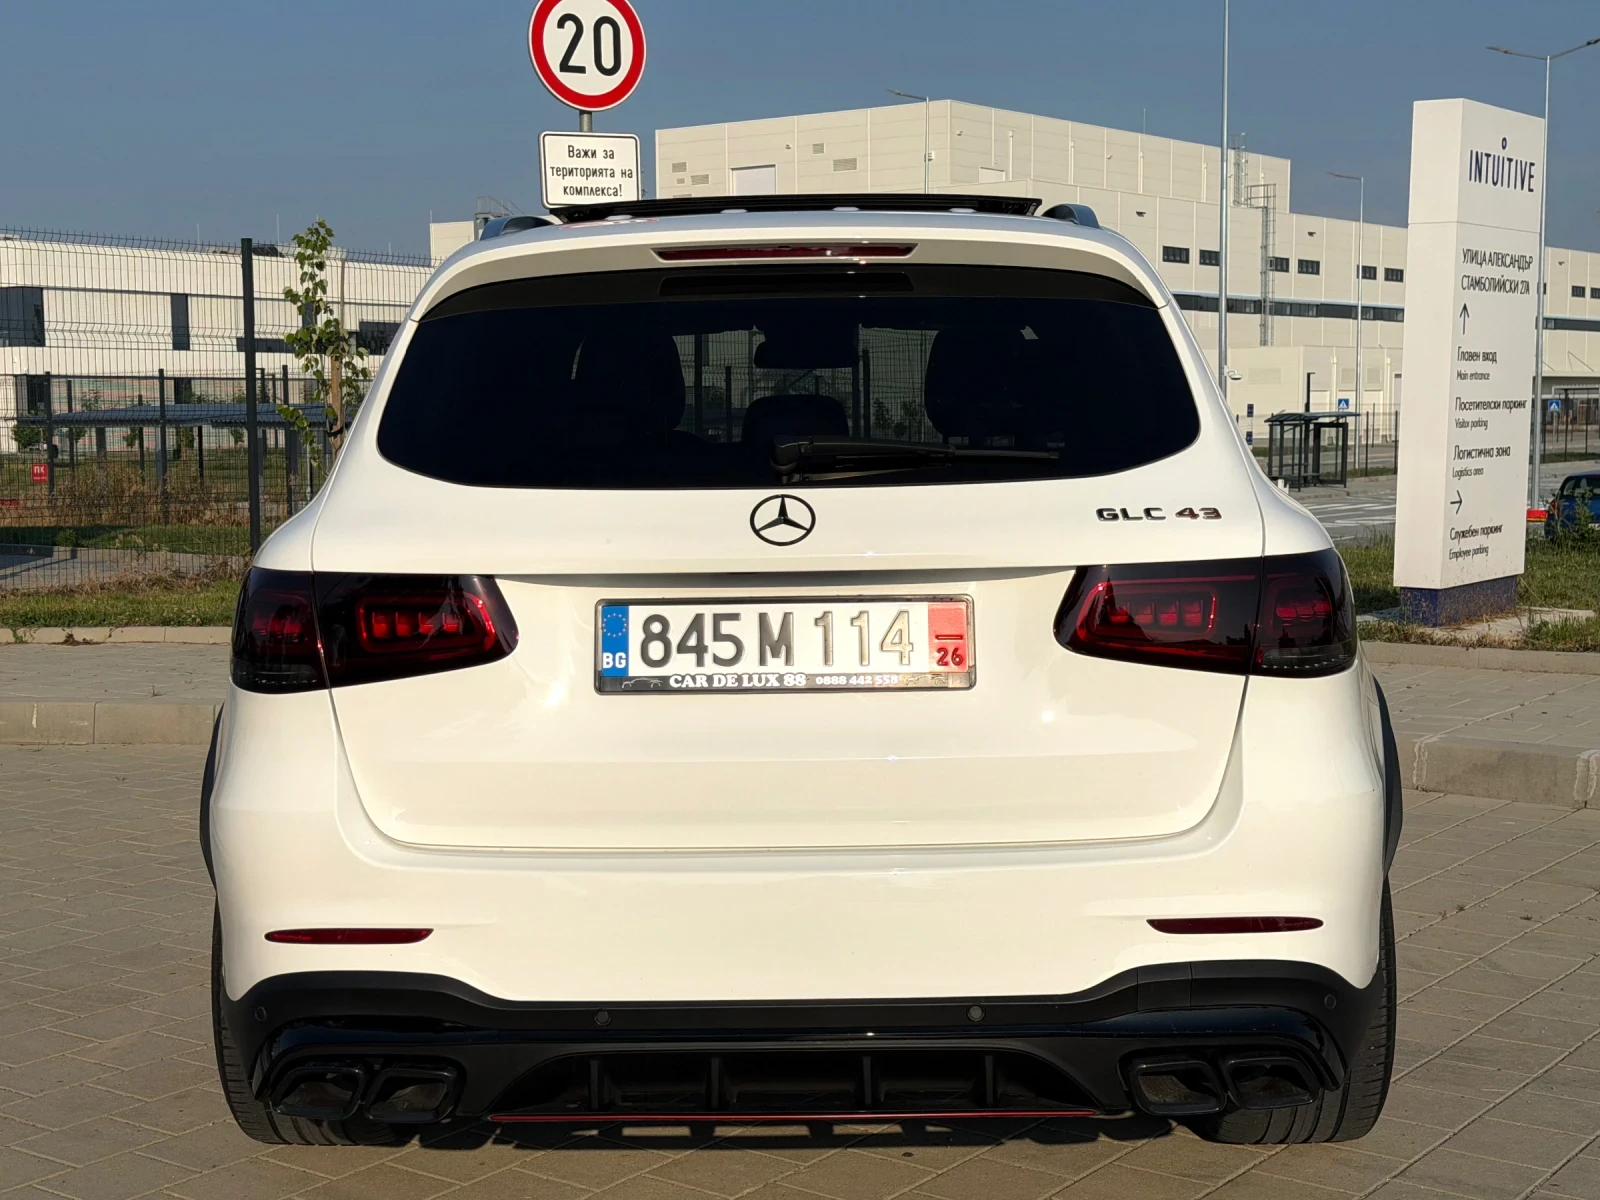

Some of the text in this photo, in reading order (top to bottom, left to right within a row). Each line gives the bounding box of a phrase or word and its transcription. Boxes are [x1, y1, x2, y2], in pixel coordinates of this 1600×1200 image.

[556, 12, 621, 76] 20
[567, 144, 615, 159] Важи за
[549, 166, 633, 180] територията на
[1469, 149, 1535, 192] INTUITIVE
[562, 184, 623, 197] комплекса!
[1462, 248, 1533, 272] УЛИЦА АЛЕКСАНДЪР
[1461, 274, 1519, 294] СТАМБОЛИЙСКИ
[1457, 346, 1497, 364] Главен вход
[1456, 370, 1490, 380] Main entrance
[1455, 397, 1527, 413] Посетителски паркинг
[1455, 417, 1488, 430] Visitor parking
[1453, 445, 1511, 460] Логистична зона
[1452, 467, 1484, 480] Logistics area
[1096, 507, 1222, 522] GLC 43
[1450, 524, 1503, 545] Служебен паркинг
[1449, 544, 1489, 562] Employee parking
[640, 610, 914, 668] 845 M 114
[602, 651, 626, 669] BG
[935, 647, 964, 666] 26
[669, 673, 807, 688] CAR DE LUX 88
[815, 676, 847, 685] 0888
[849, 675, 872, 685] 442
